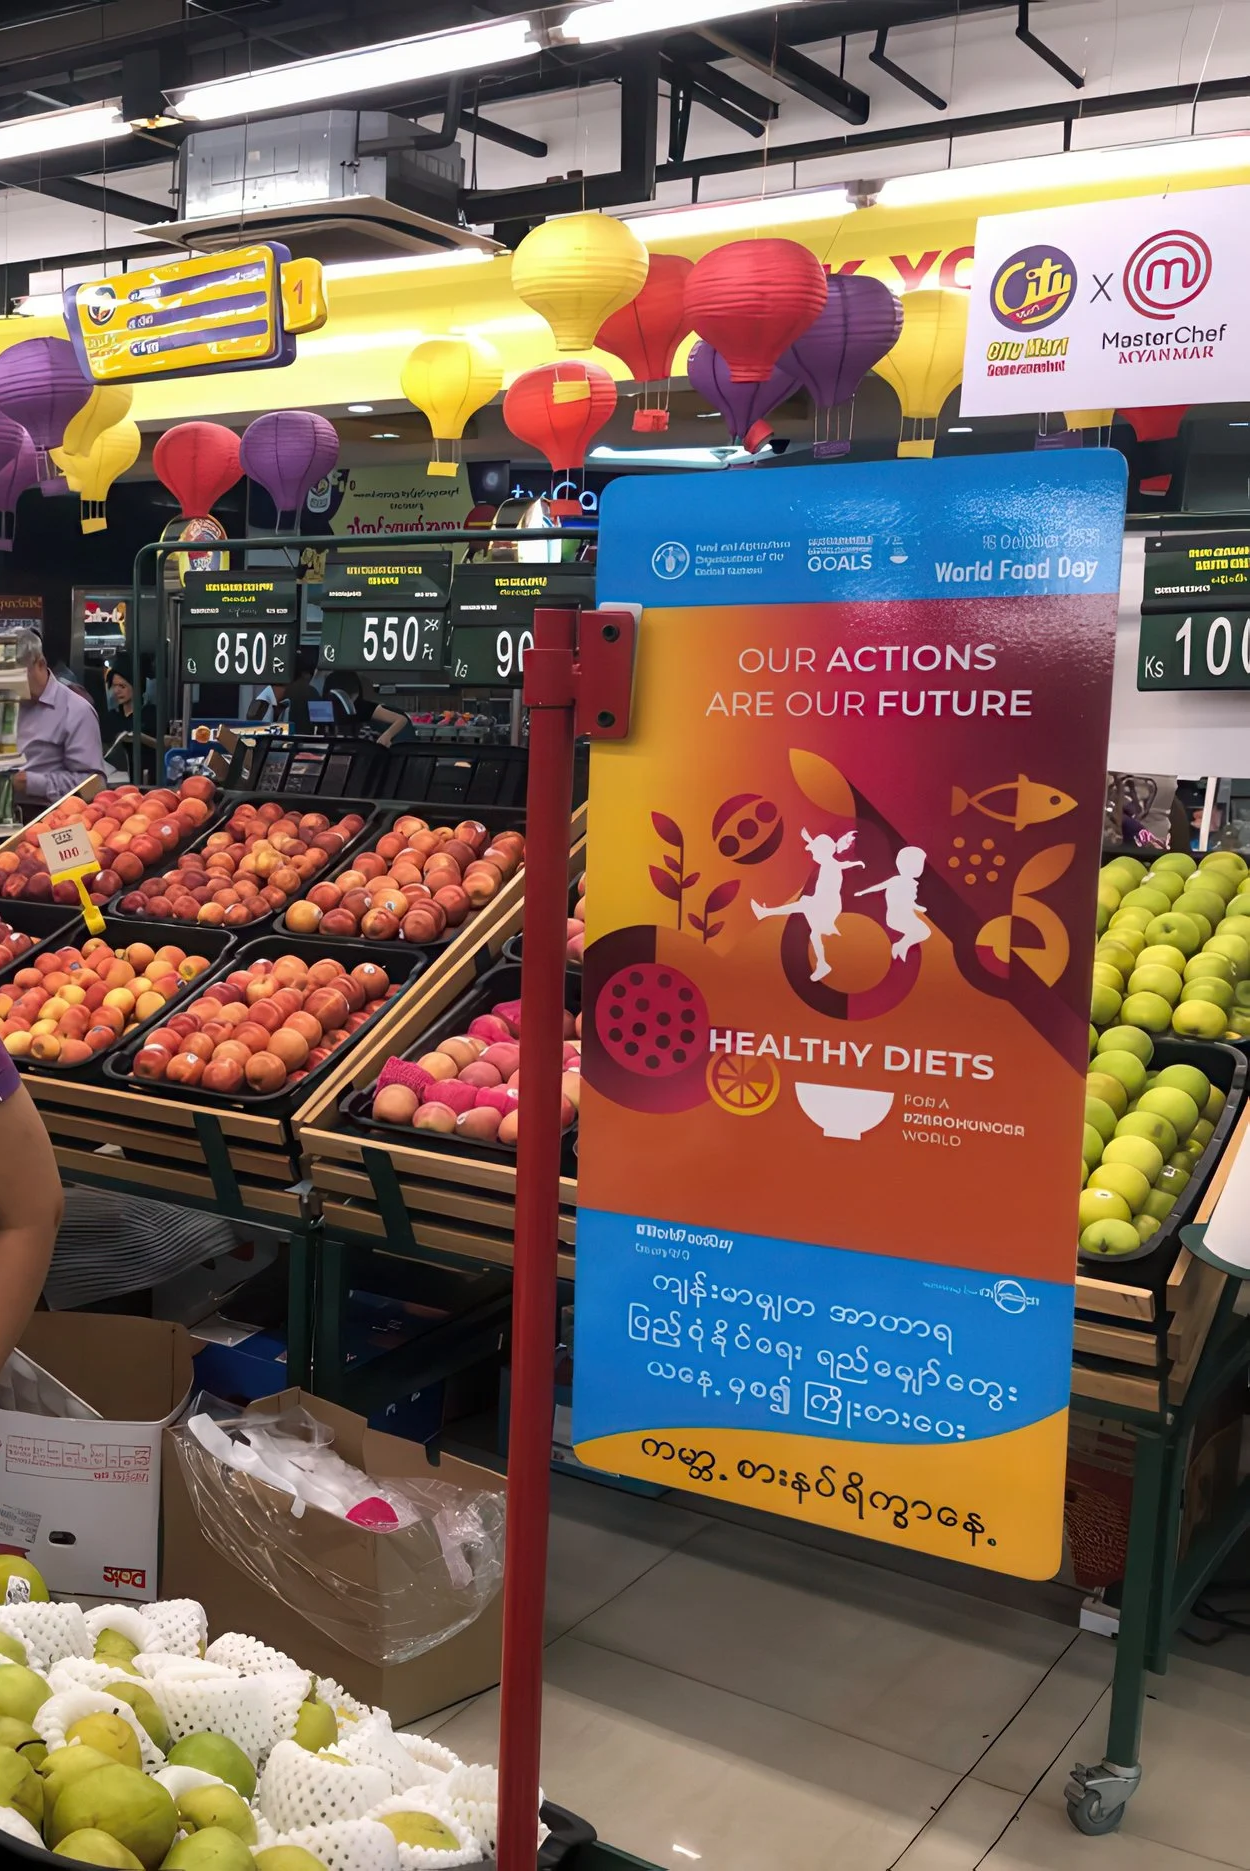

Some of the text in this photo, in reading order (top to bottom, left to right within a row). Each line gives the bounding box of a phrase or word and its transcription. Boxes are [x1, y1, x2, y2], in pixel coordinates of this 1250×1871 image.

[1102, 324, 1227, 350] MasterChef
[1118, 346, 1215, 365] MYANMAR
[807, 554, 873, 573] GOALS
[935, 556, 1098, 583] World Food Day
[362, 616, 419, 662] 550
[214, 631, 267, 675] 850
[738, 643, 997, 674] OUR ACTIONS
[1144, 655, 1164, 679] Ks
[705, 690, 1034, 717] ARE OUR FUTURE
[709, 1028, 996, 1081] HEALTHY DIETS
